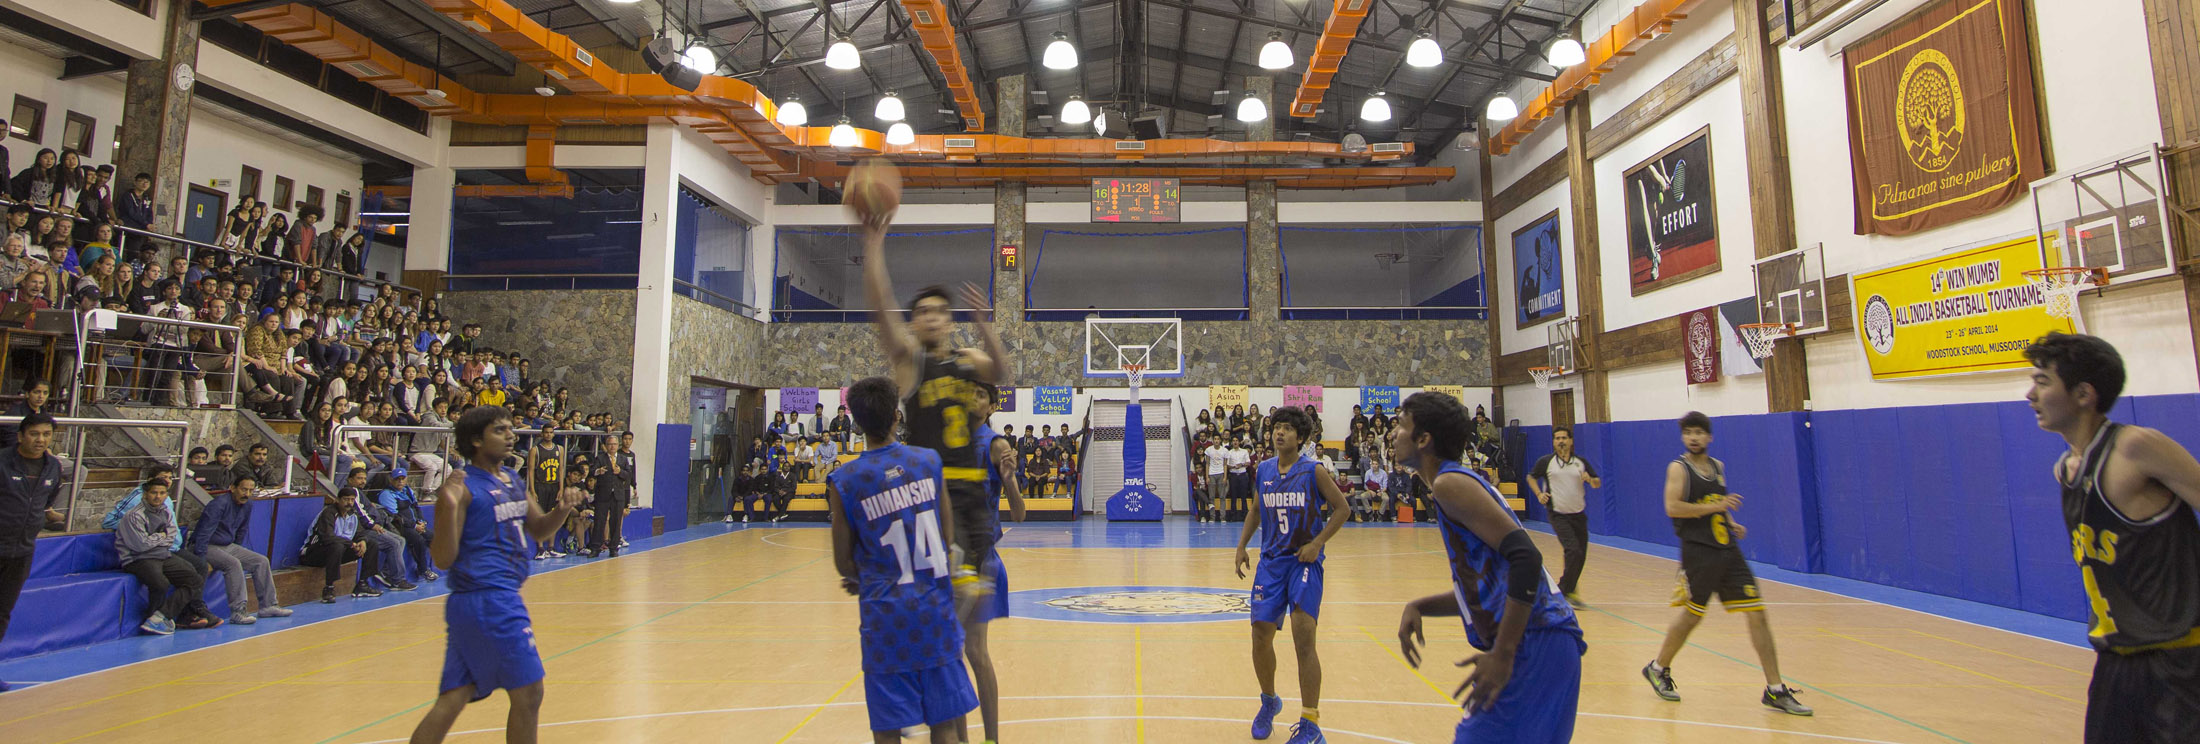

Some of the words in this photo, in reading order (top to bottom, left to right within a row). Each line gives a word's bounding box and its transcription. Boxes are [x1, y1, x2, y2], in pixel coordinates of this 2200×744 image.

[1928, 155, 1947, 168] 1854
[1916, 180, 1937, 197] non
[1939, 171, 1964, 190] sine
[1095, 188, 1108, 199] 16
[1165, 188, 1178, 199] 14
[1661, 202, 1698, 236] EFFORT
[1005, 255, 1016, 267] 19
[1945, 265, 1967, 290] WIN
[1967, 260, 2001, 286] MUMBY
[1528, 288, 1562, 315] COMMITMENT
[1895, 306, 1910, 326] ALL
[1909, 301, 1935, 325] INDIA
[1934, 292, 1988, 320] BASKETBALL
[1987, 284, 2047, 312] TOURNAME
[1968, 326, 1985, 336] APRIL
[1985, 324, 1999, 335] 2014
[1925, 347, 1962, 360] WOODSTOCK
[1961, 344, 1989, 357] SCHOOL,
[1041, 387, 1069, 396] Vasant
[1222, 386, 1236, 394] The
[1296, 386, 1311, 394] The
[1367, 387, 1398, 396] Modern
[1216, 393, 1241, 401] Asian
[1367, 396, 1391, 404] School
[1124, 477, 1144, 486] STAG
[1262, 492, 1306, 508] MODERN
[1276, 508, 1290, 535] 5
[1710, 513, 1730, 545] 6
[880, 508, 949, 586] 14
